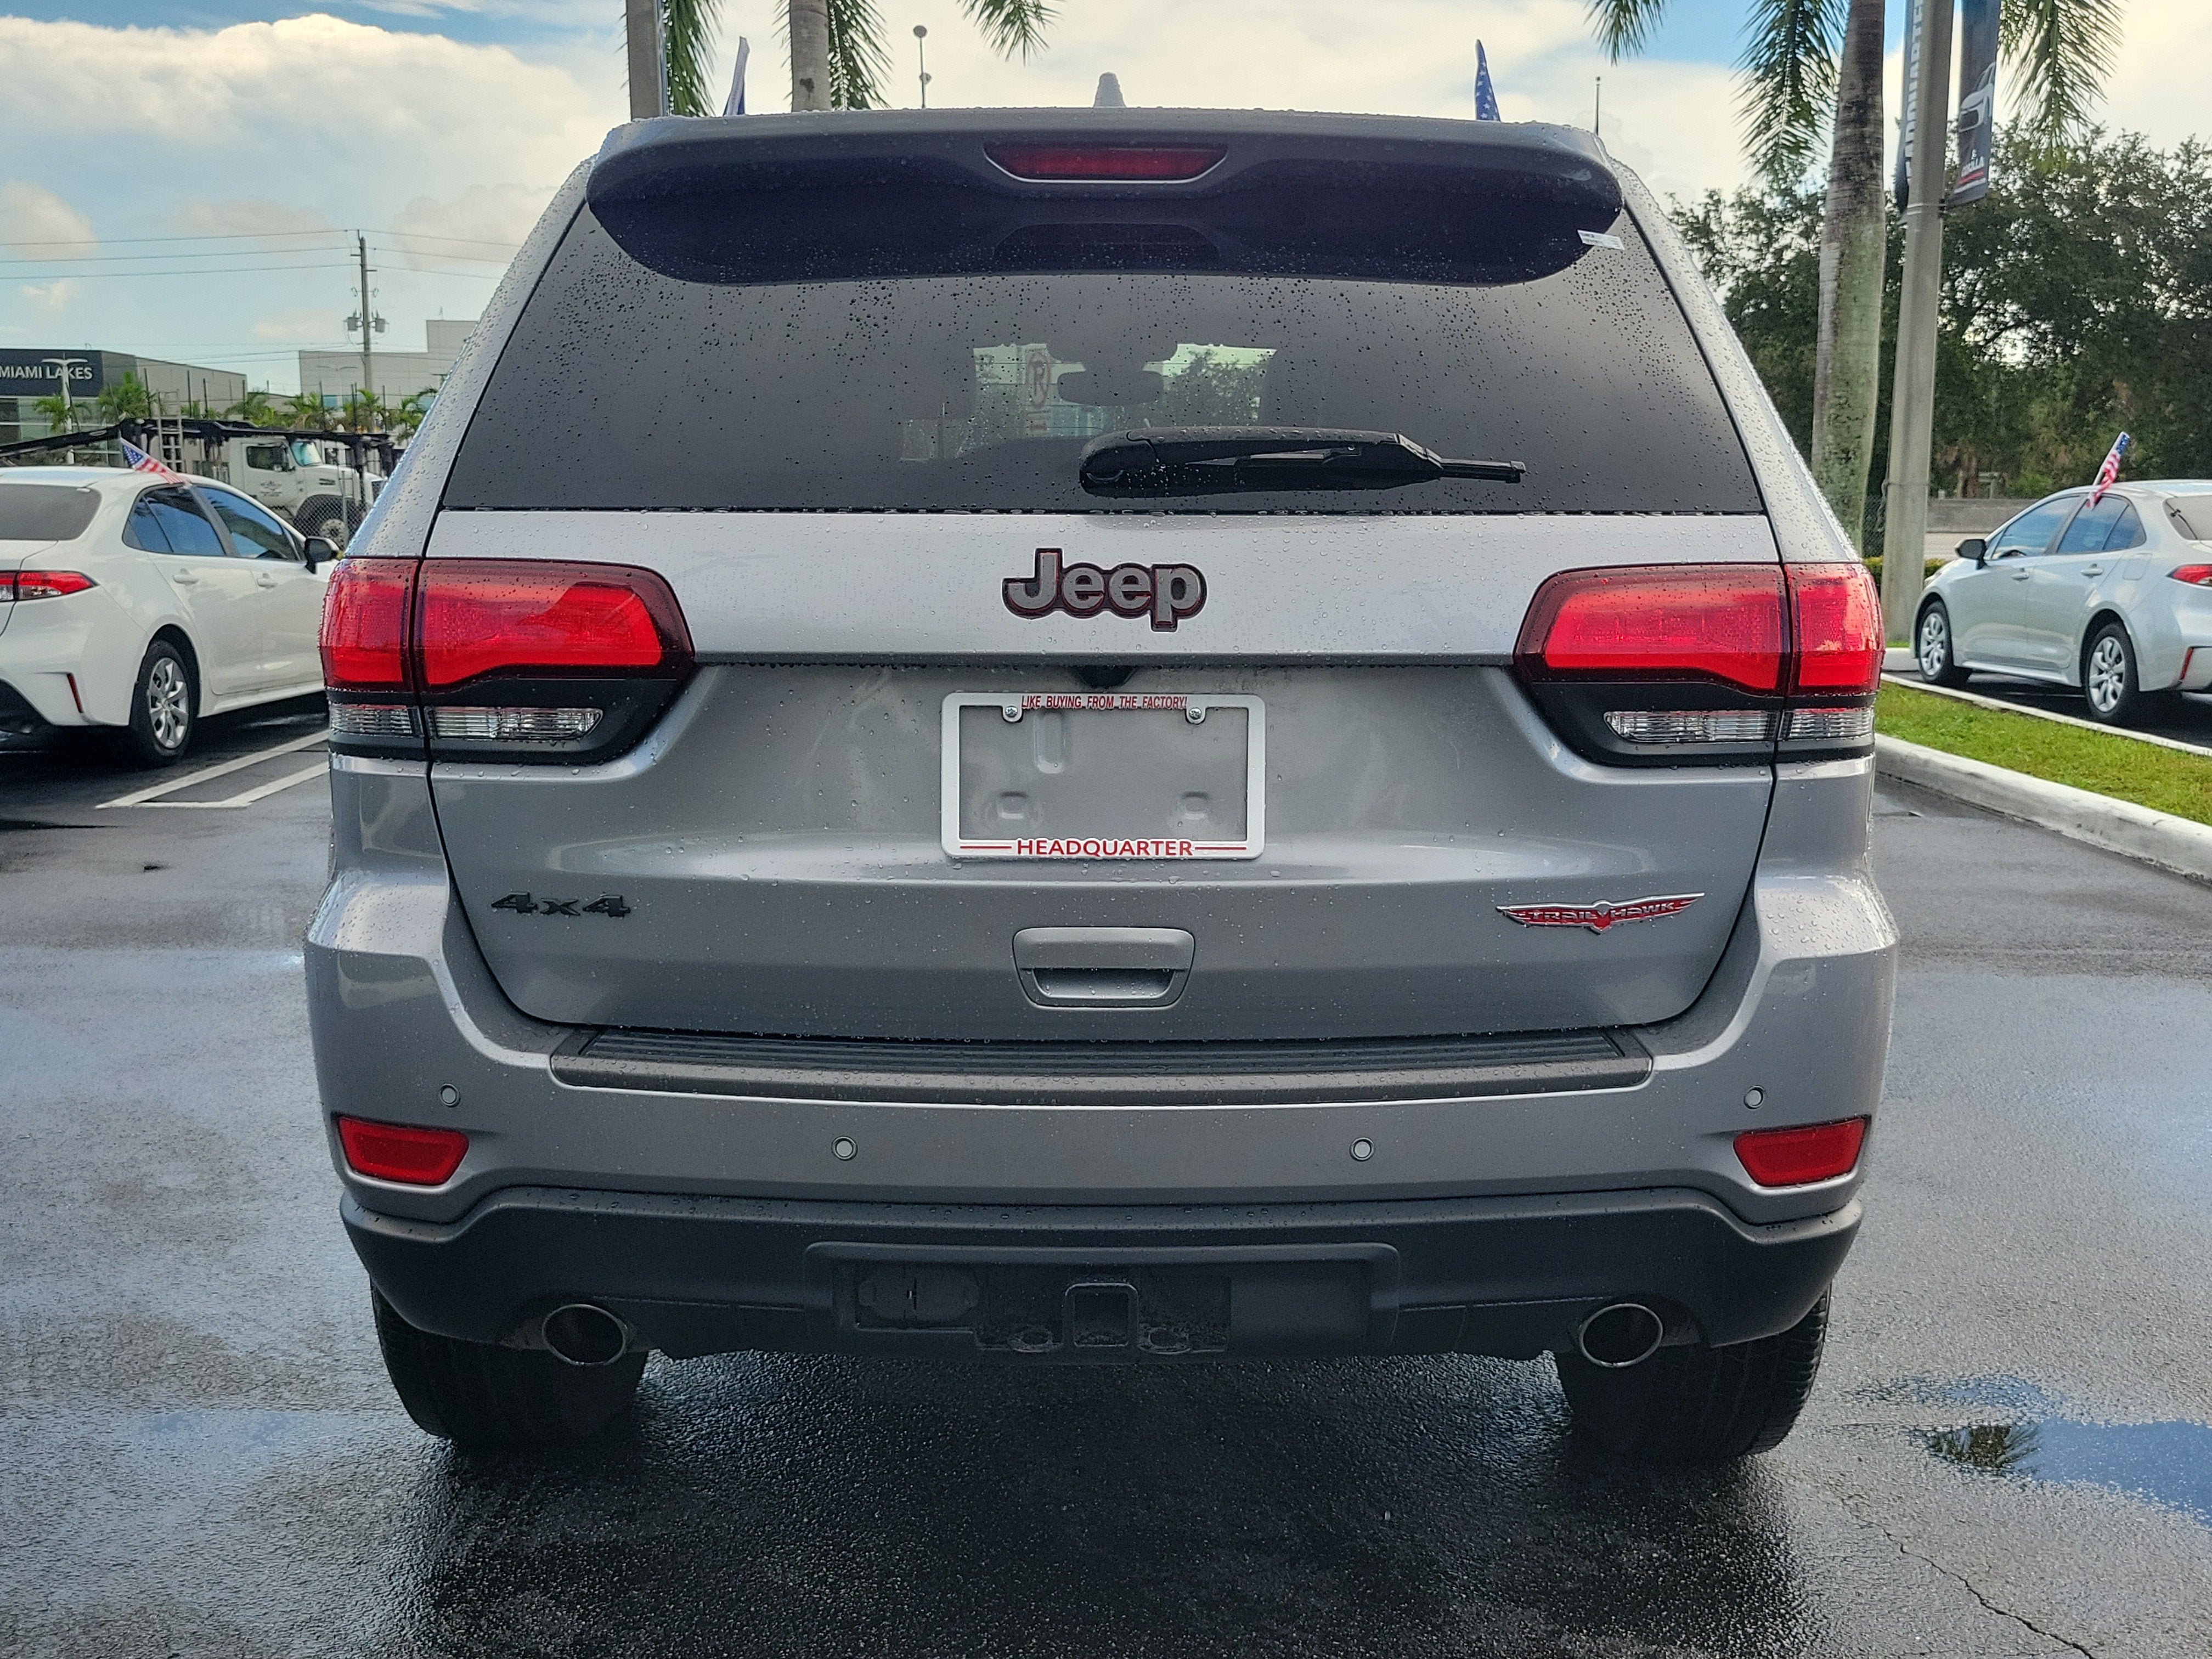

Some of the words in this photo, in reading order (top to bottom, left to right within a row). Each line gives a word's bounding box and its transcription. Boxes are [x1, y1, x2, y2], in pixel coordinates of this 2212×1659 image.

[0, 365, 43, 379] MIAMI
[46, 366, 93, 380] LAKES
[1002, 548, 1207, 631] Jeep
[1022, 696, 1041, 708] LIKE
[1046, 696, 1082, 708] BUYING
[1087, 696, 1114, 708] FROM
[1119, 696, 1137, 708] THE
[1142, 696, 1188, 709] FACTORY!
[1017, 840, 1193, 856] HEADQUARTER
